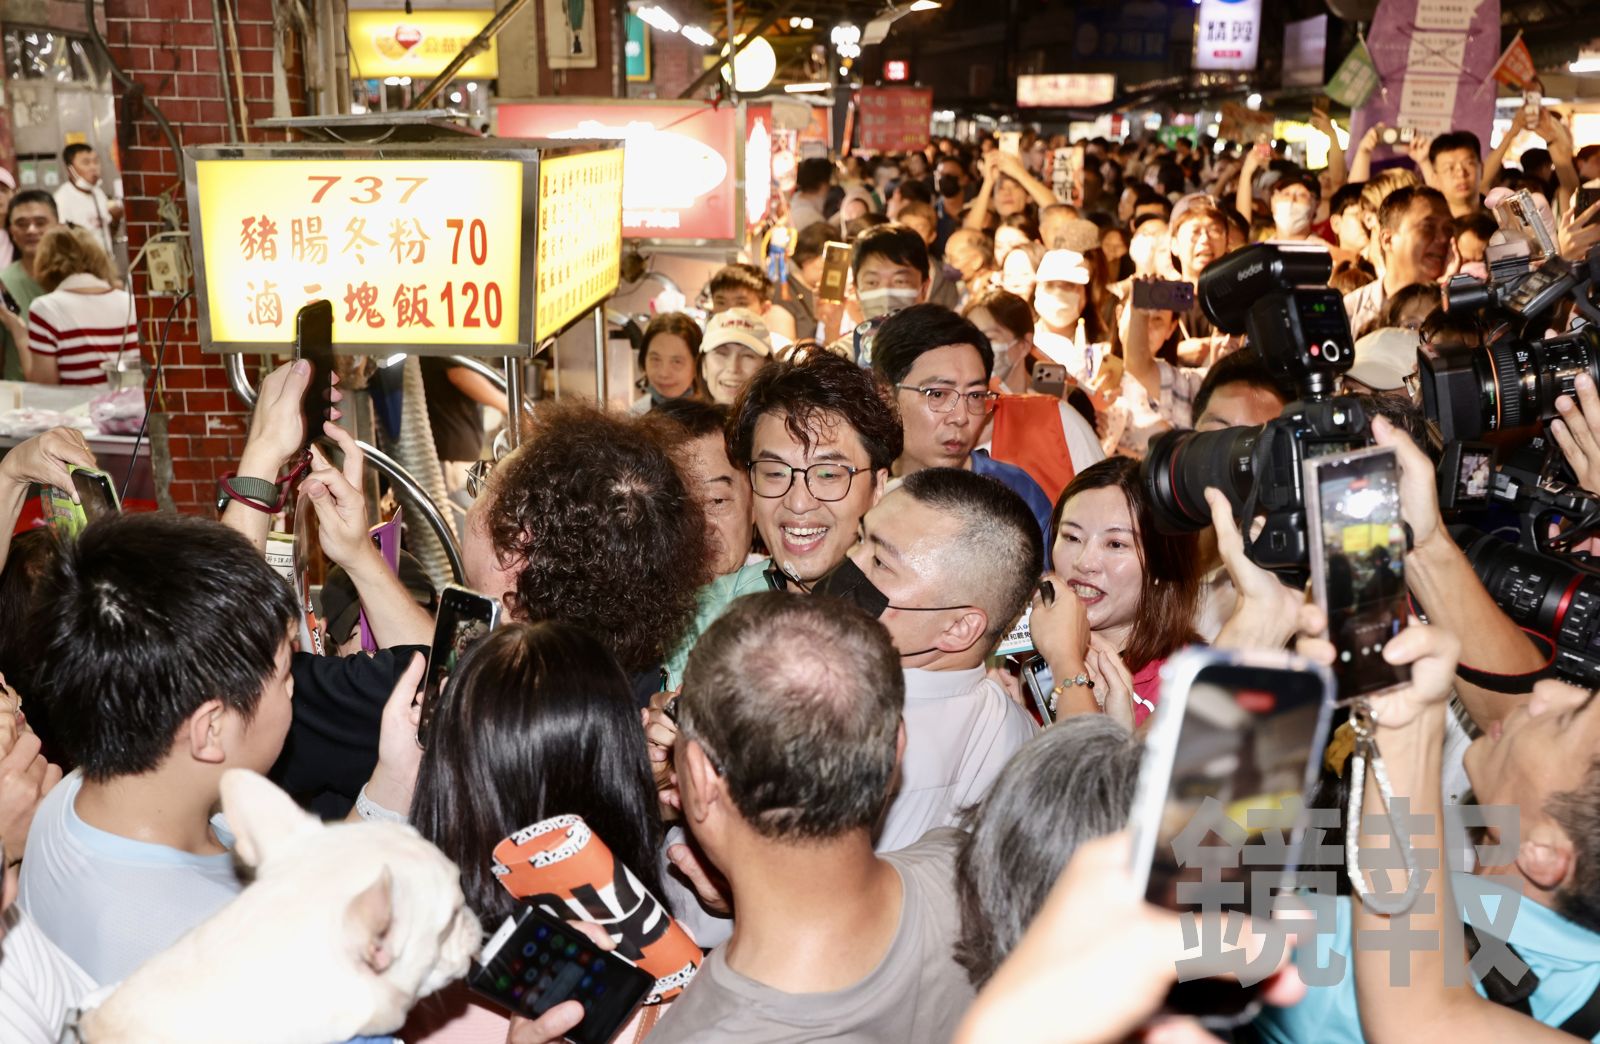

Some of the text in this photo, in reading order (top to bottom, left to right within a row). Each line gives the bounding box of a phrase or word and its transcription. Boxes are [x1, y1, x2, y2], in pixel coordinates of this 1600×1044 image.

[307, 175, 429, 205] 737
[239, 214, 488, 266] 豬腸冬粉 70
[440, 280, 503, 329] 120
